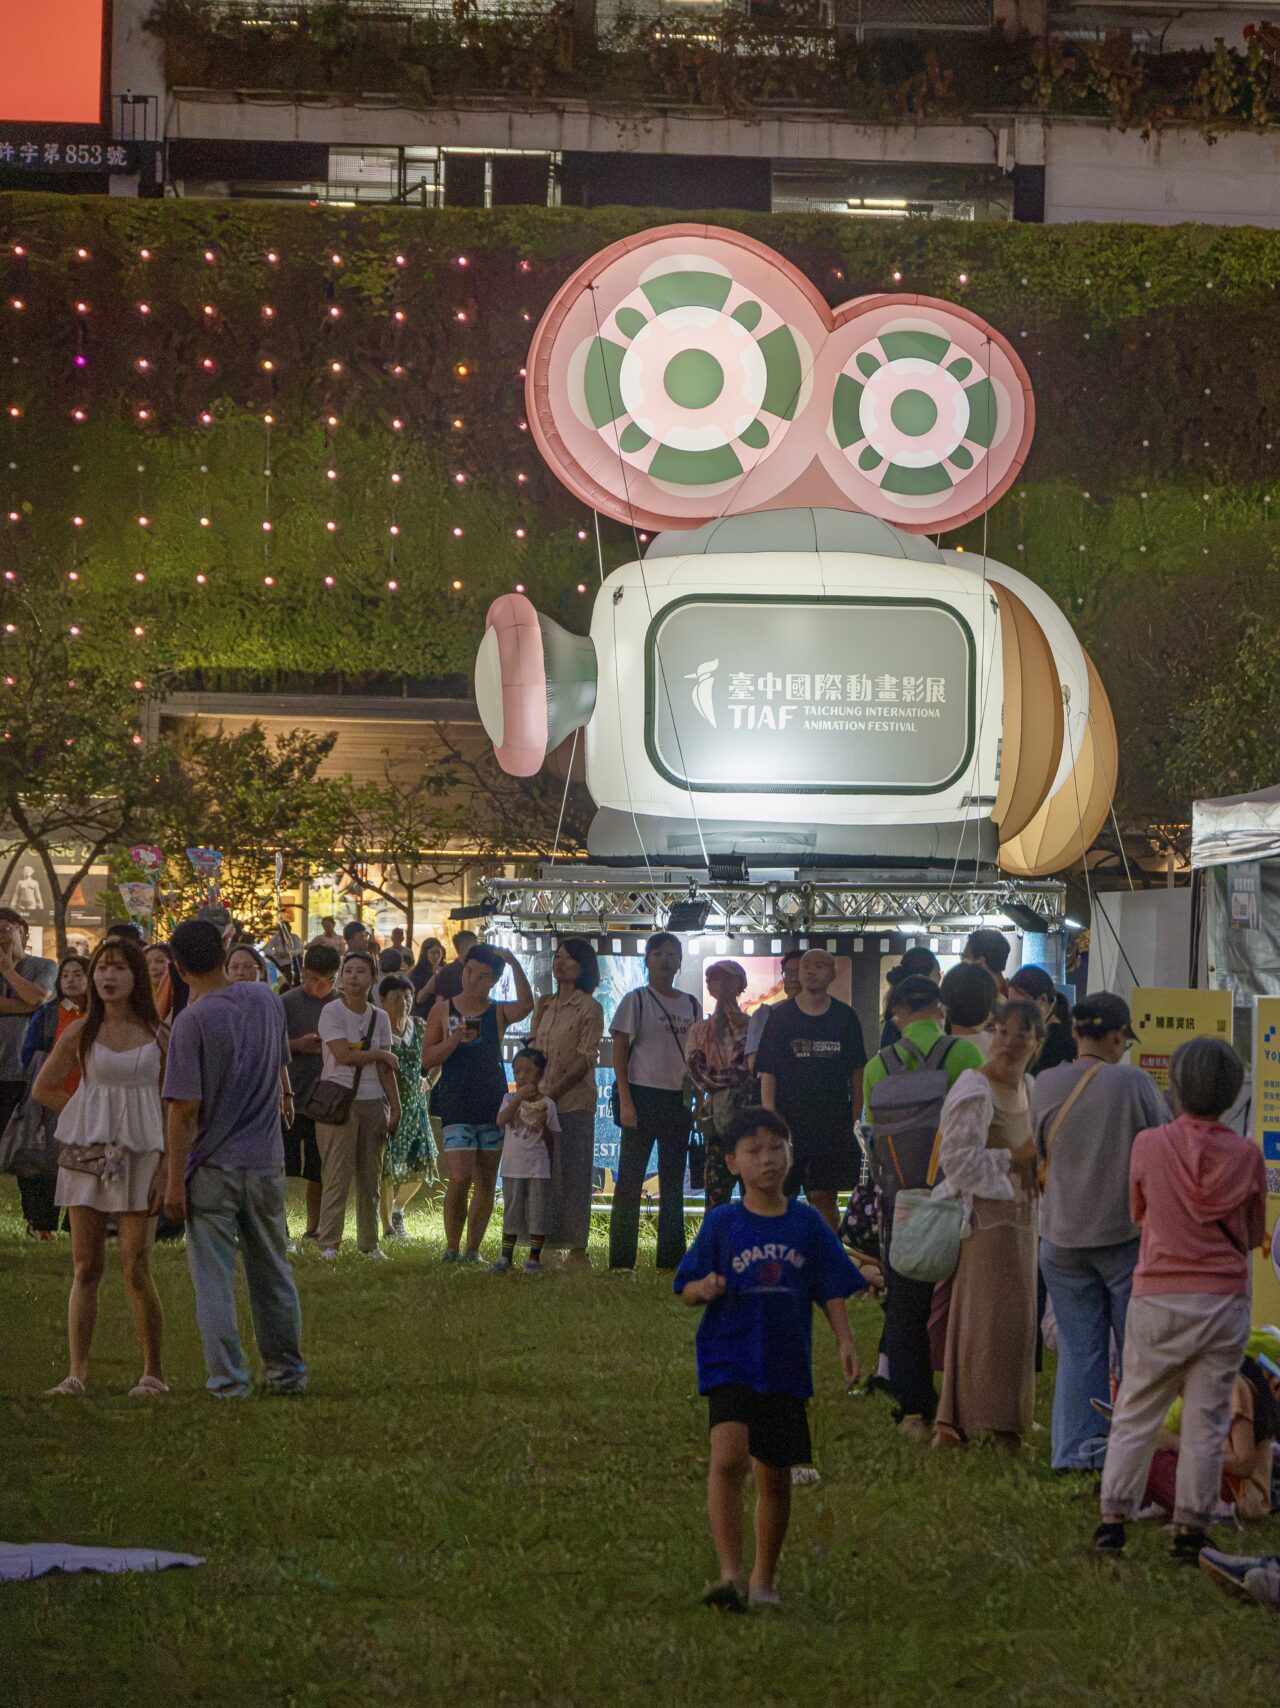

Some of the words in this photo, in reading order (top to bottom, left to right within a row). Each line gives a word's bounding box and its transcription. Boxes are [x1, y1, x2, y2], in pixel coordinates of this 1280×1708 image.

[728, 672, 946, 703] 臺中國際動畫影展
[728, 705, 798, 730] TIAF
[803, 705, 863, 717] TAICHUNG
[865, 706, 941, 718] INTERNATIONA
[802, 721, 864, 731] ANIMATION
[868, 721, 918, 732] FESTIVAL
